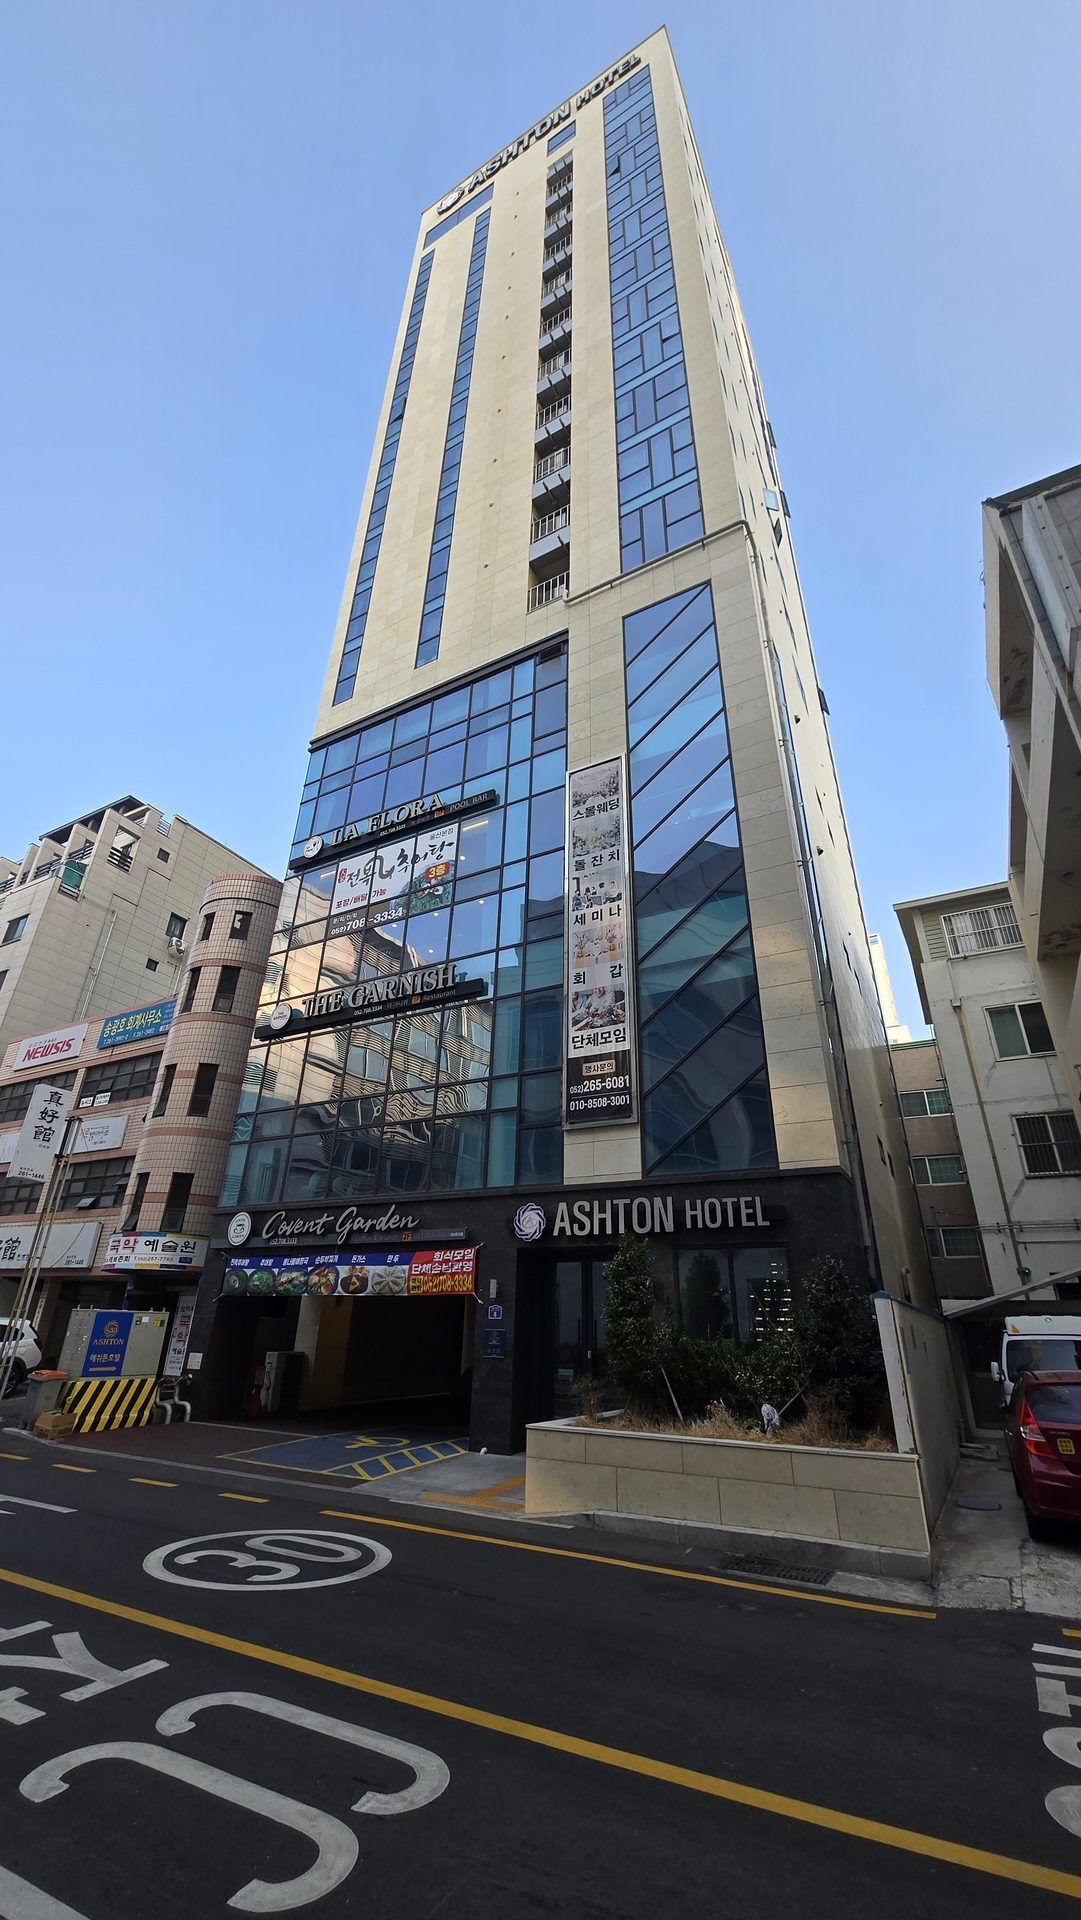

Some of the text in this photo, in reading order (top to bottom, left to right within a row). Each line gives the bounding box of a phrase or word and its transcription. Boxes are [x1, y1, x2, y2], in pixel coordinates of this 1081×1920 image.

[470, 54, 641, 192] ASHTON HOTEL
[450, 793, 488, 812] POOL BAR
[572, 798, 620, 821] 스몰웨딩
[331, 793, 444, 847] LA FLORA
[396, 841, 455, 874] 추어탕
[573, 850, 620, 872] 돌잔치
[428, 863, 446, 878] 3층
[336, 888, 387, 910] 포장/배달 가능
[573, 905, 622, 926] 세미나
[573, 964, 624, 985] 회갑
[302, 963, 457, 1018] THE GARNISH
[423, 989, 457, 1001] Restaurant
[103, 1017, 127, 1038] 송광호
[126, 1009, 162, 1031] 회계사무소
[22, 1038, 76, 1062] NEWSIS
[571, 1028, 626, 1050] 단체모임
[584, 1062, 614, 1074] 행사문의
[570, 1075, 630, 1094] 052)265-6081
[570, 1095, 630, 1111] 010-8508-3001
[33, 1091, 64, 1143] 真好館
[262, 1204, 420, 1244] Covent Garden
[553, 1196, 770, 1237] ASHTON HOTEL
[110, 1238, 197, 1254] 국악 예술원
[402, 1233, 411, 1241] 2F
[433, 1248, 474, 1262] 회식모임
[411, 1261, 473, 1274] 단체손님환영
[174, 1534, 362, 1582] 30
